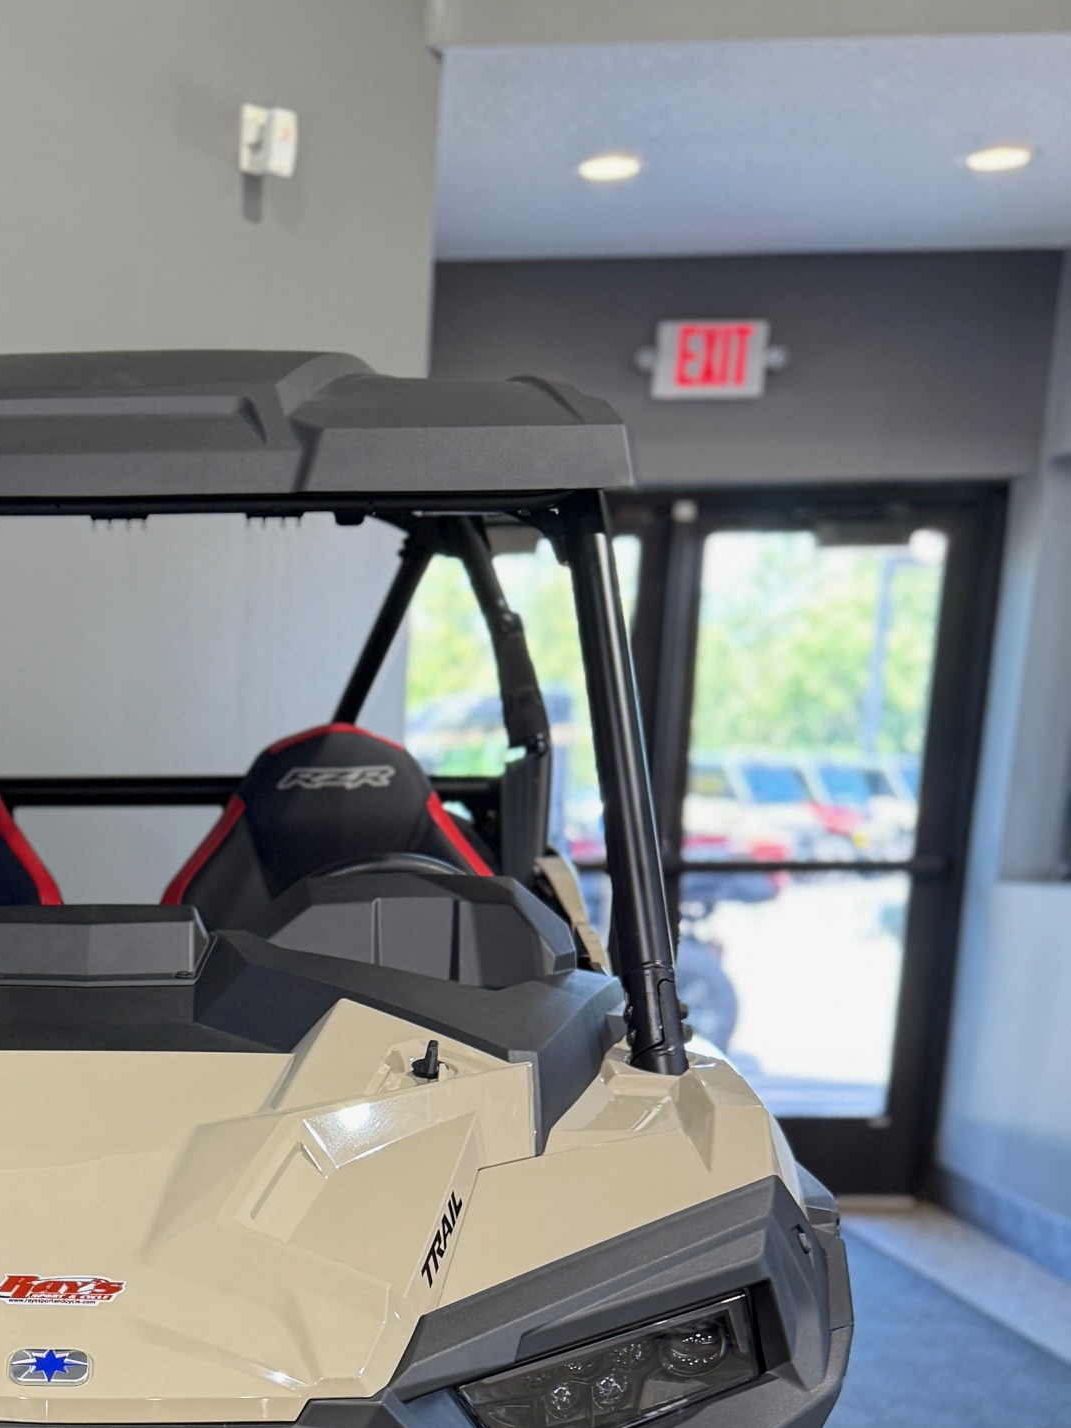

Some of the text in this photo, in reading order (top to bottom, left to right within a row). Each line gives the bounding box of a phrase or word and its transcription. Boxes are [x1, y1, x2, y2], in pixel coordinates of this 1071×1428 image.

[674, 323, 756, 388] EXIT
[277, 765, 396, 791] RZR
[421, 1190, 463, 1289] TRAIL
